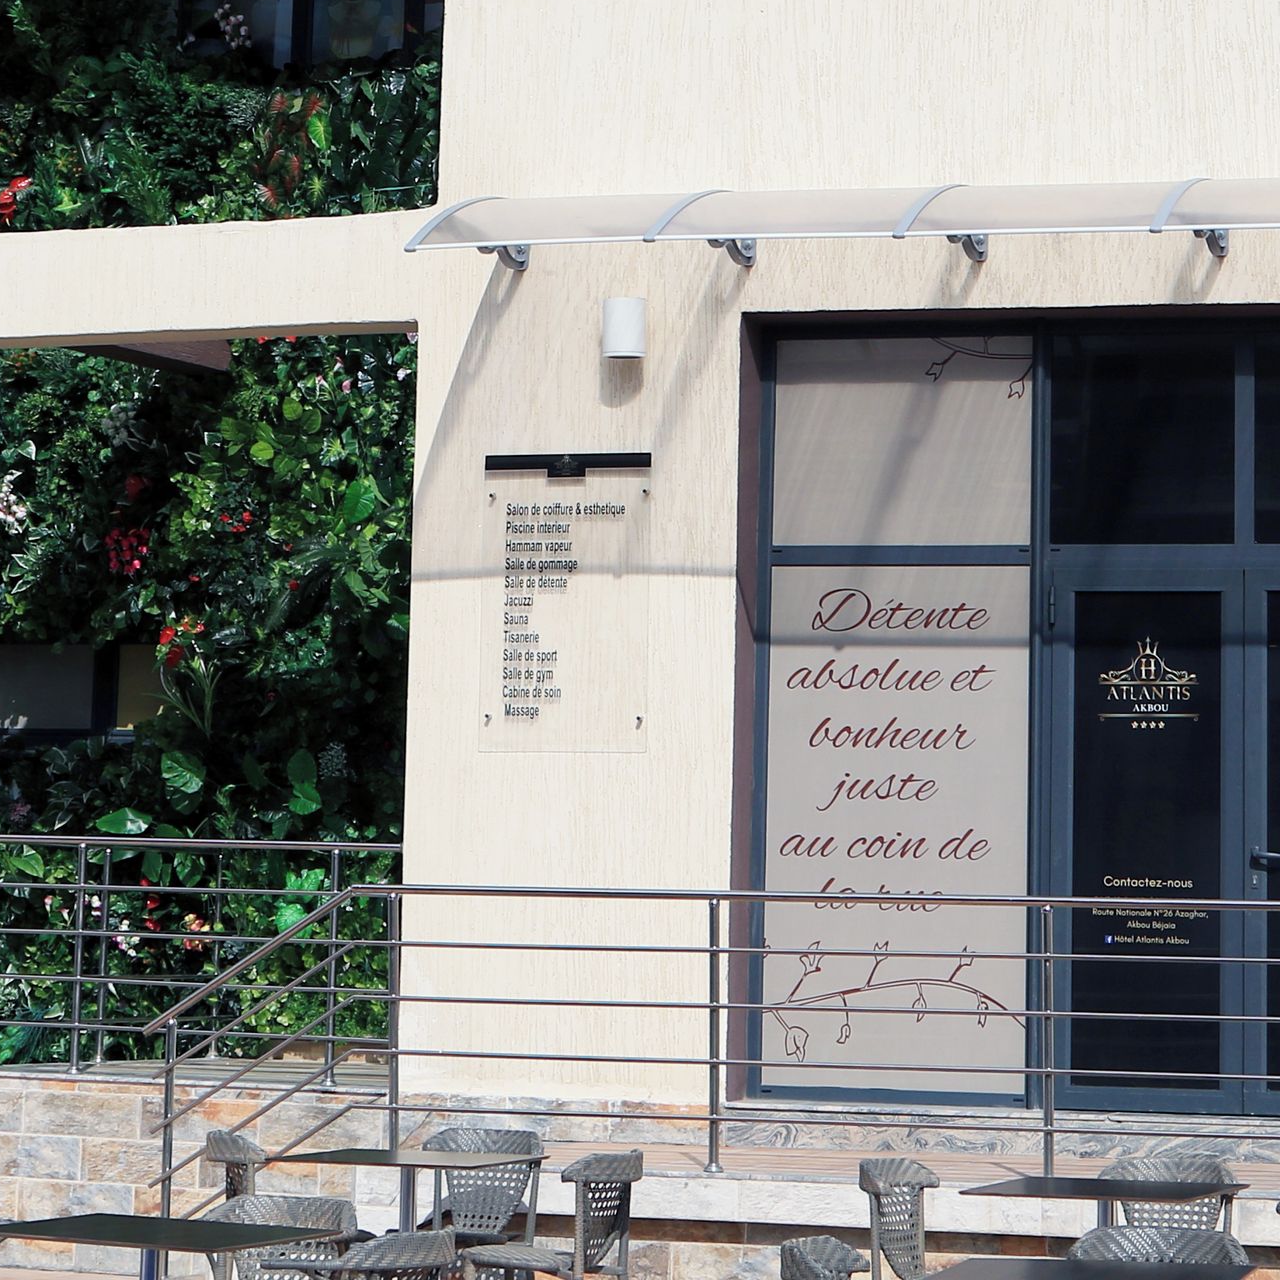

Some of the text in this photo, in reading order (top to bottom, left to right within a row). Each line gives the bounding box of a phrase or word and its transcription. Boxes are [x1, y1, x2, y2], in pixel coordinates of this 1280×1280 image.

[506, 501, 626, 517] Salon de coiffure & esthetique
[506, 521, 570, 534] Piscine interieur
[505, 539, 572, 554] Hammam vapeur
[504, 557, 578, 573] Salle de gommage
[504, 575, 568, 588] Salle de détente
[504, 593, 534, 607] Jacuzzi
[811, 588, 990, 632] Détente
[503, 612, 528, 625] Sauna
[503, 630, 539, 643] Tisanerie
[503, 648, 558, 664] Salle de sport
[502, 667, 553, 682] Salle de gym
[786, 658, 997, 692] absolue et
[1140, 658, 1156, 680] H
[502, 685, 561, 698] Cabine de soin
[1107, 685, 1191, 701] ATLANTIS
[504, 704, 539, 719] Massage
[1132, 703, 1169, 713] AKBOU
[808, 716, 976, 750] bonheur
[815, 772, 939, 812] juste
[778, 828, 991, 861] au coin de
[1103, 875, 1193, 888] Contactez-nous
[1092, 908, 1114, 916] Route
[1115, 908, 1152, 917] Nationale
[1127, 921, 1150, 929] Akbou
[1114, 935, 1134, 943] Hôtel
[1135, 935, 1164, 944] Atlantis
[1166, 936, 1190, 945] Akbou
